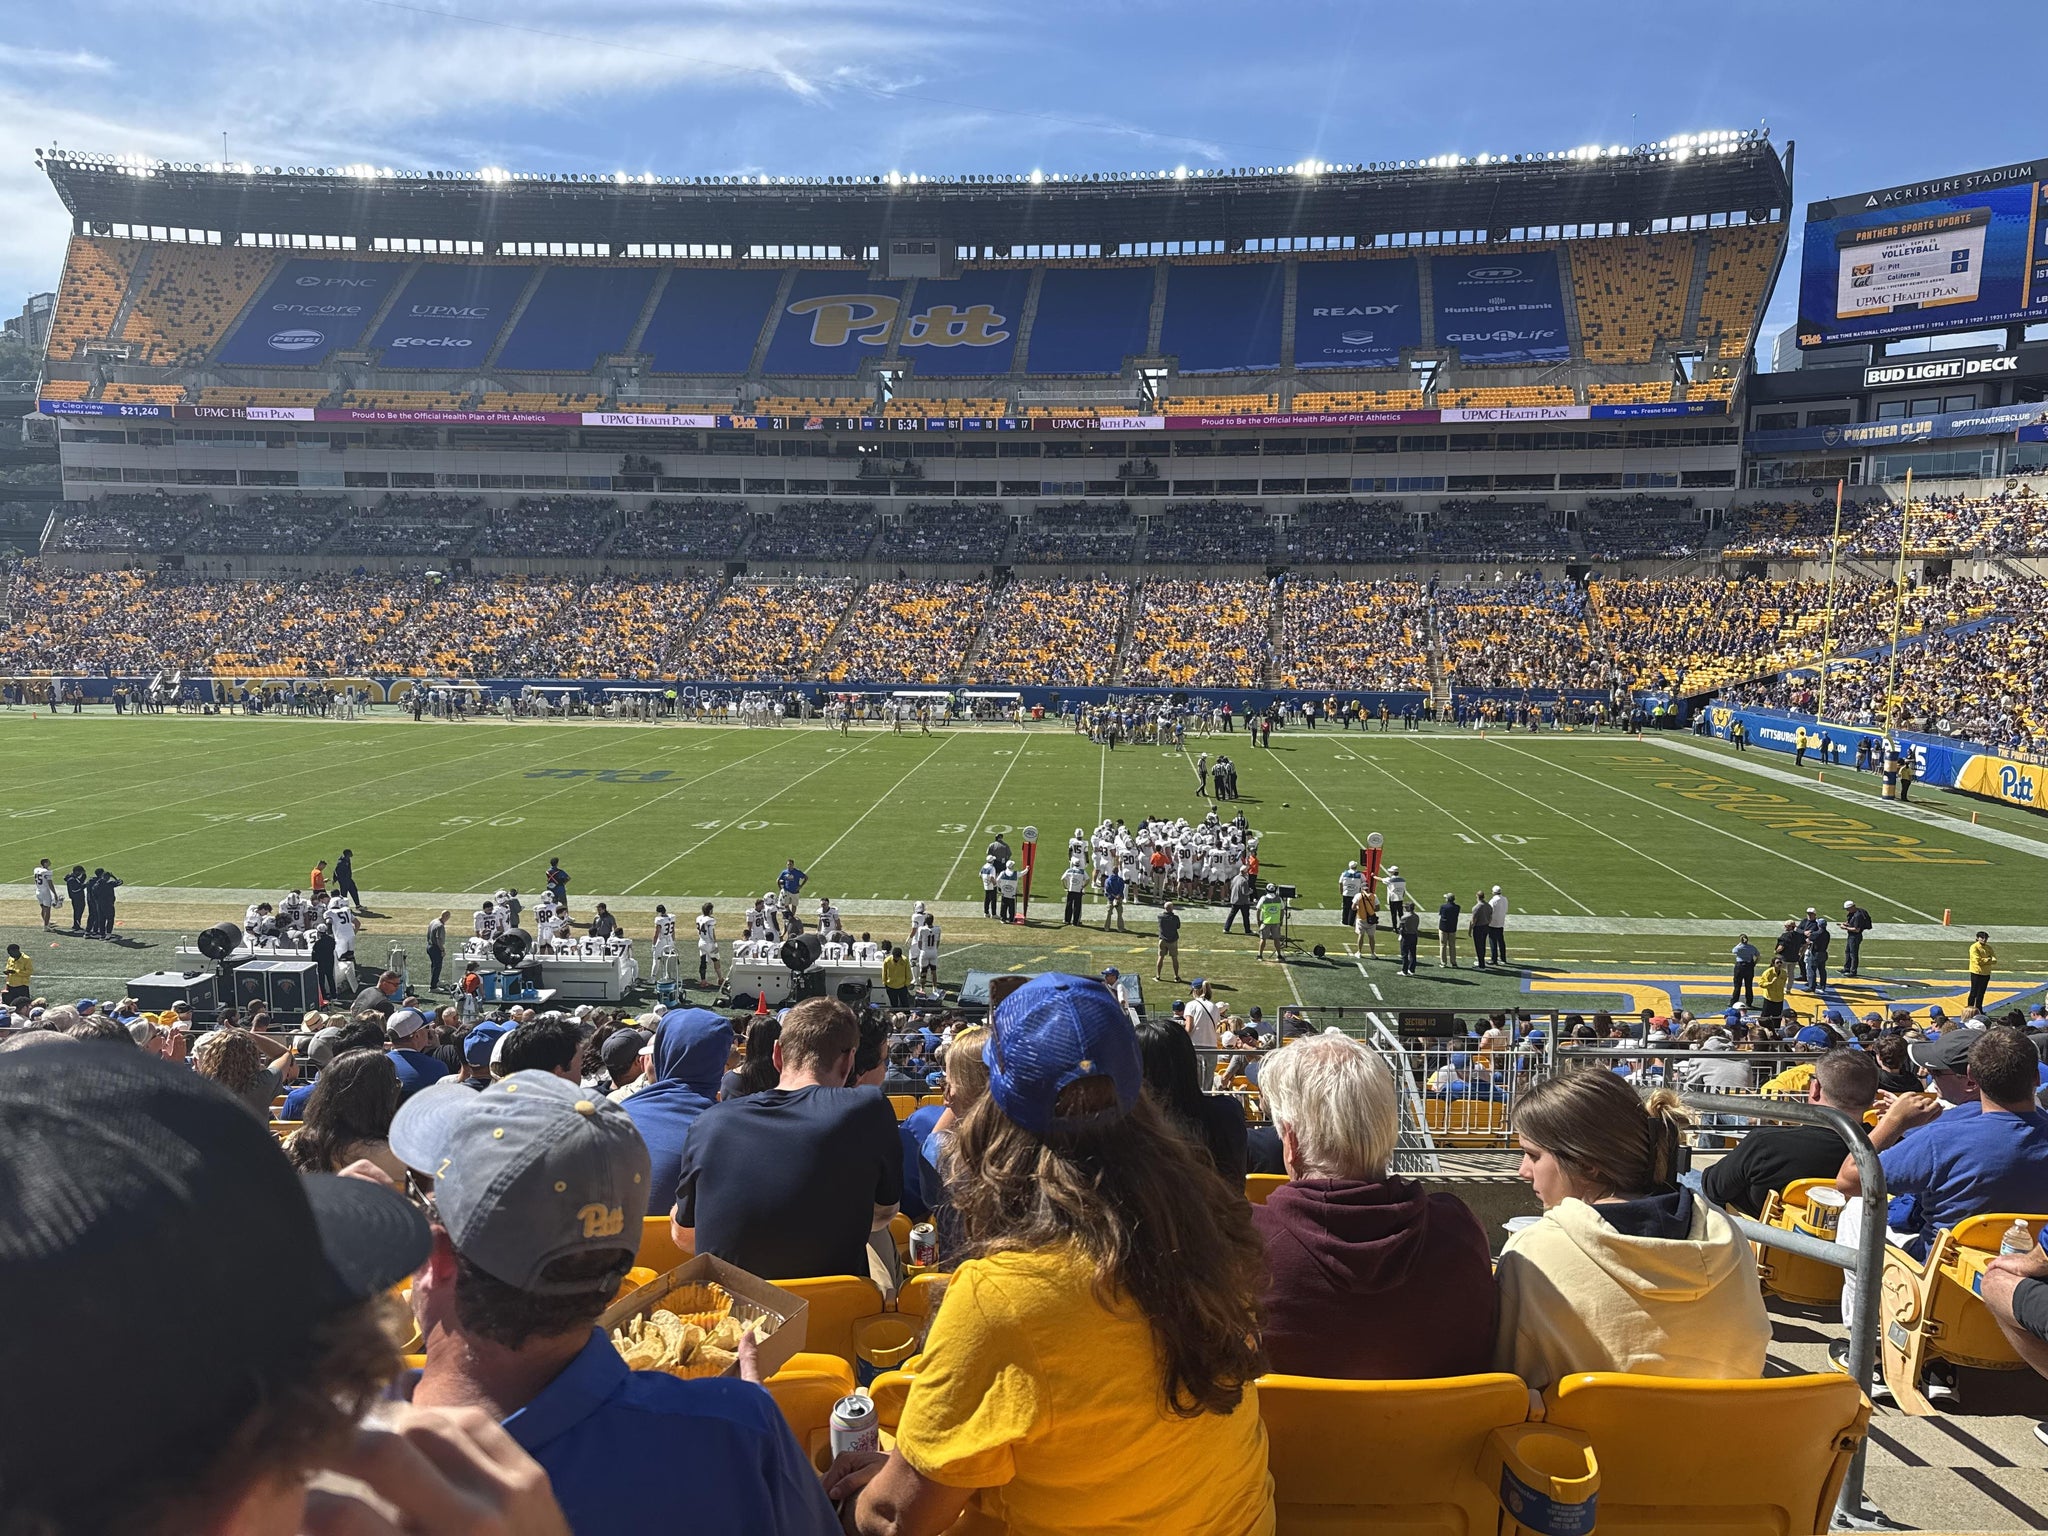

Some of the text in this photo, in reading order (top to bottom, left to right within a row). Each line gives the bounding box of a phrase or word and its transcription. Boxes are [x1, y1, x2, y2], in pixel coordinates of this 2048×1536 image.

[1884, 166, 2033, 202] ACRISURE STADIUM
[1855, 213, 1971, 241] PANTHERS SPORTS UPDATE
[1882, 243, 1940, 259] VOLLEYBALL
[1887, 271, 1921, 281] California
[324, 278, 377, 287] PNC
[1856, 294, 1890, 307] UPMC
[272, 304, 362, 314] encore
[411, 304, 490, 316] UPMC
[1312, 304, 1400, 317] READY
[1444, 302, 1552, 314] Huntington Bank
[786, 293, 1011, 348] Pitt
[1446, 329, 1556, 342] GBU Life
[1880, 326, 1911, 334] CHAMPIONS
[273, 335, 321, 343] PEPSI
[392, 336, 472, 348] gecko
[1867, 356, 2019, 384] BUD LIGHT DECK
[62, 402, 103, 410] Clearview
[120, 406, 159, 416] $21,240
[1661, 406, 1677, 414] State
[194, 407, 230, 418] UPMC
[399, 412, 412, 420] the
[413, 412, 441, 420] Official
[442, 412, 467, 420] Health
[469, 413, 486, 421] Plan
[487, 413, 495, 421] of
[497, 413, 511, 421] Pitt
[512, 413, 546, 422] Athletics
[1461, 410, 1497, 420] UPMC
[601, 415, 634, 425] UPMC
[773, 418, 782, 429] 21
[847, 418, 854, 429] 0
[879, 419, 884, 428] 2
[897, 419, 918, 430] 6:34
[985, 420, 993, 429] 10
[1021, 420, 1028, 428] 17
[1052, 419, 1084, 429] UPMC
[1201, 418, 1224, 426] Proud
[1236, 417, 1247, 425] Be
[1248, 417, 1261, 425] the
[1263, 416, 1291, 424] Official
[1292, 415, 1318, 424] Health
[1319, 415, 1337, 423] Plan
[1338, 414, 1348, 422] of
[1349, 414, 1364, 422] Pitt
[1365, 413, 1401, 422] Athletics
[1999, 765, 2034, 802] Pitt
[1573, 754, 1997, 866] PITTSBURGH
[1073, 845, 1082, 854] 15
[1179, 849, 1191, 859] 90
[1123, 855, 1135, 865] 20
[287, 911, 300, 921] 78
[337, 911, 350, 924] 51
[484, 920, 496, 931] 89
[663, 922, 675, 935] 33
[585, 942, 593, 956] 5
[611, 944, 626, 957] 27
[577, 1203, 624, 1238] Pitt
